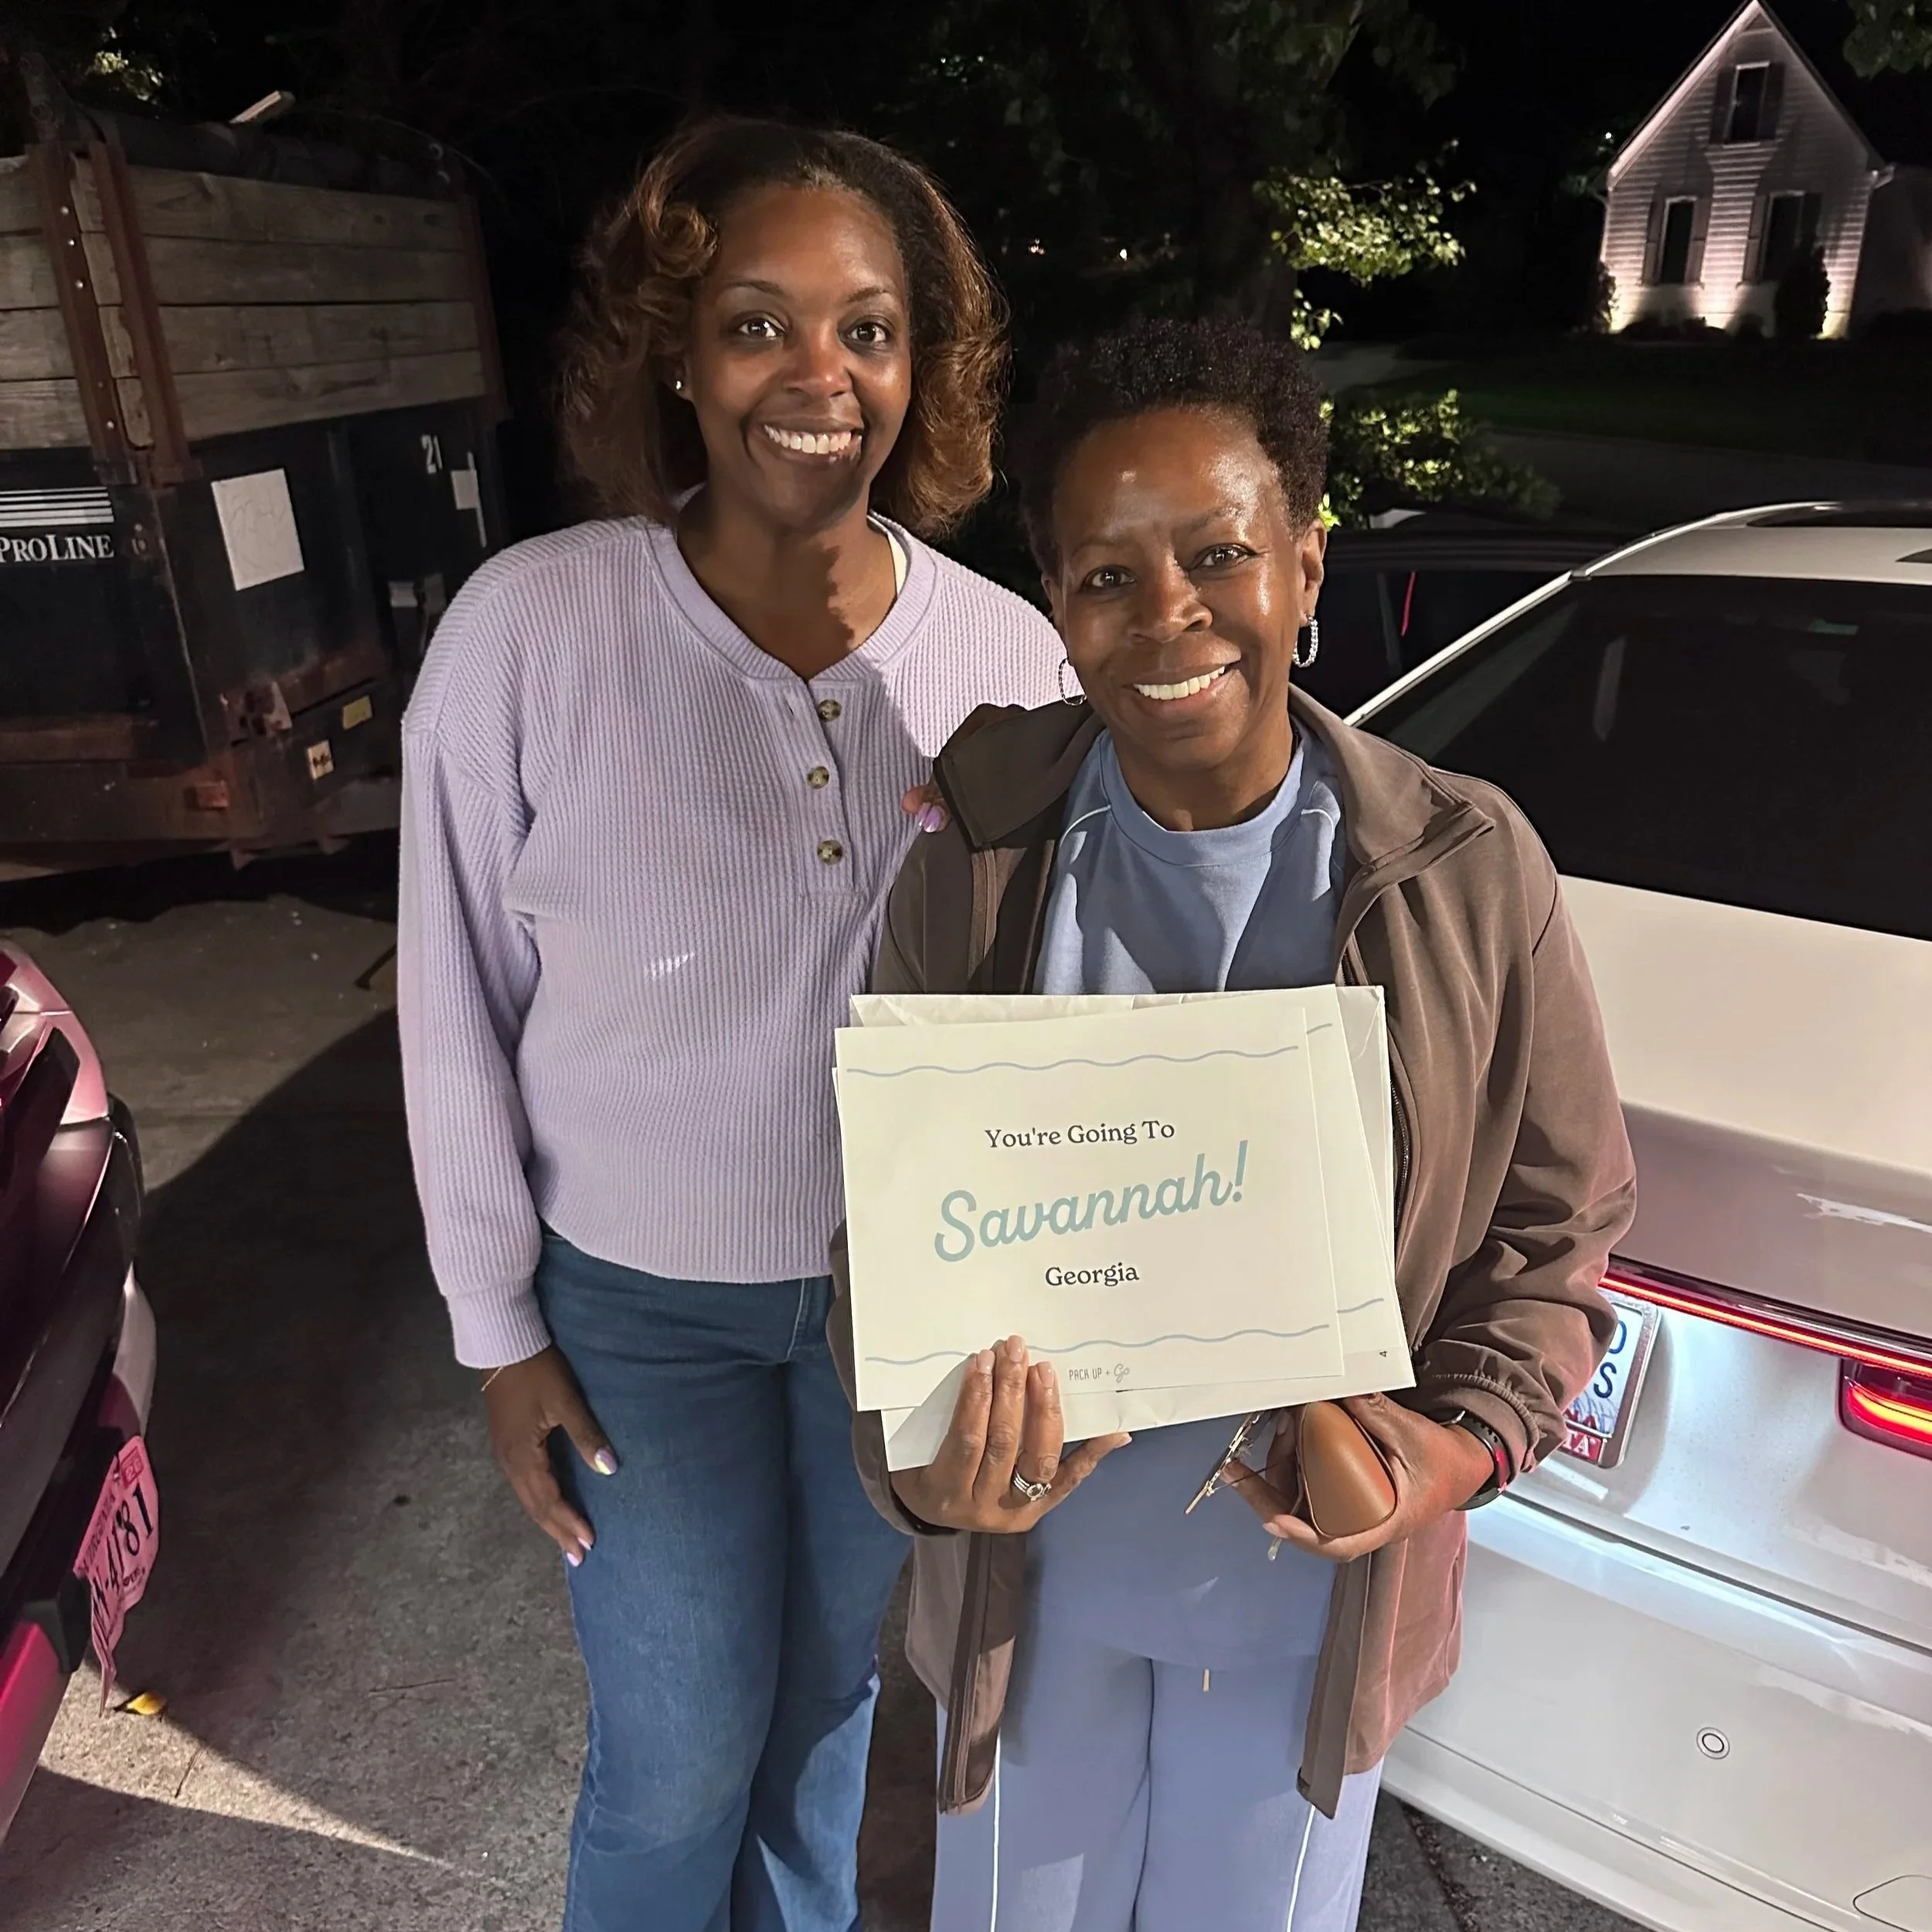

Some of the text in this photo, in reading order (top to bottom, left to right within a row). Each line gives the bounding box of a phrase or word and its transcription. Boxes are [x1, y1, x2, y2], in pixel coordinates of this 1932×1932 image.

[985, 1120, 1175, 1148] You're Going To
[934, 1140, 1248, 1262] Savannah!
[1045, 1263, 1140, 1287] Georgia
[1069, 1368, 1090, 1381] PACK
[1092, 1367, 1102, 1379] UP
[1114, 1363, 1131, 1383] Go
